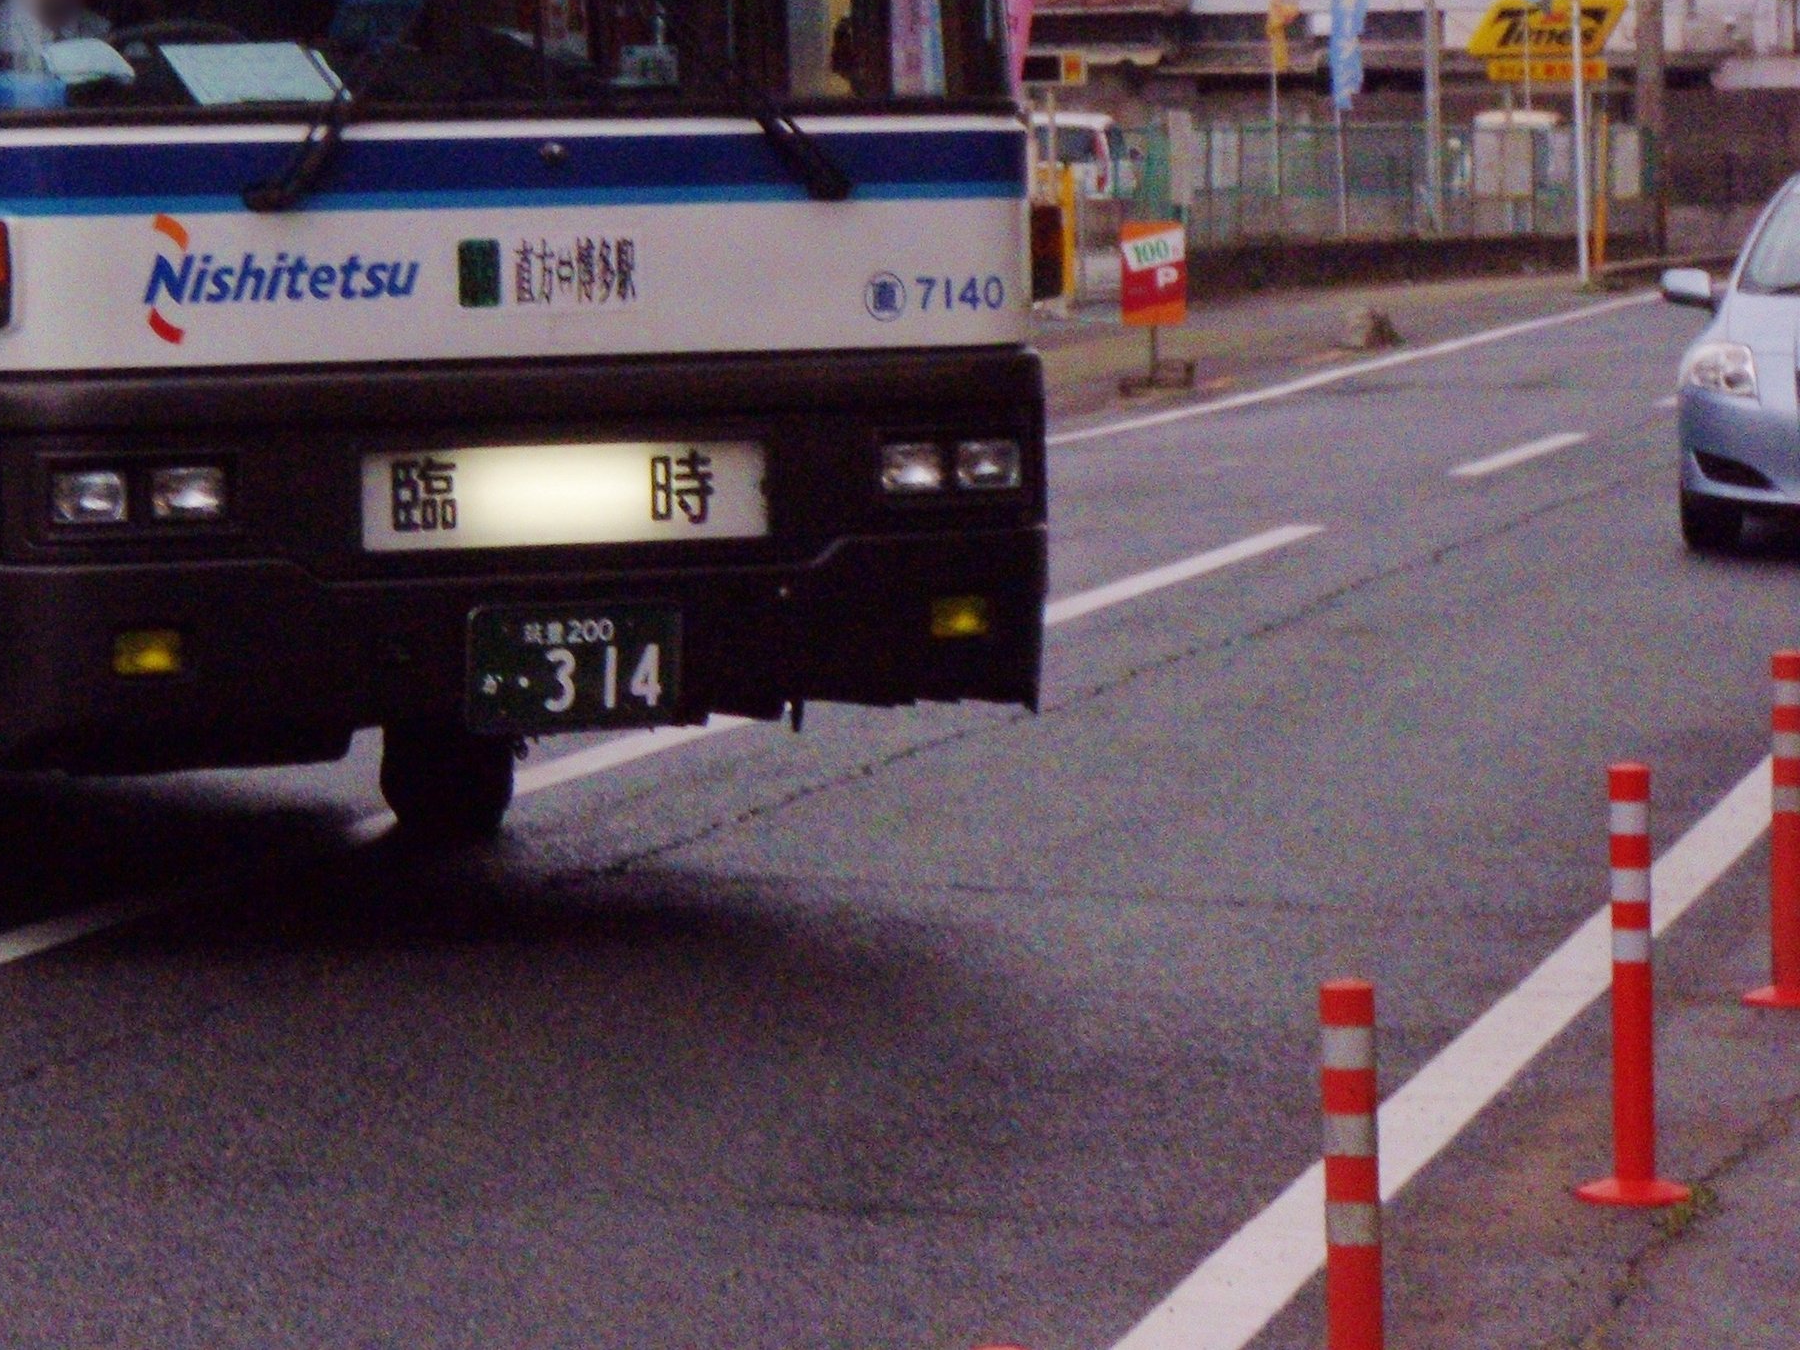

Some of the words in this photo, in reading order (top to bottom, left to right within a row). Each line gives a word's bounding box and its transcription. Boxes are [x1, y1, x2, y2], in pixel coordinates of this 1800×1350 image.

[144, 253, 419, 305] Nishitetsu
[915, 275, 1004, 310] 7140
[1156, 265, 1179, 290] P
